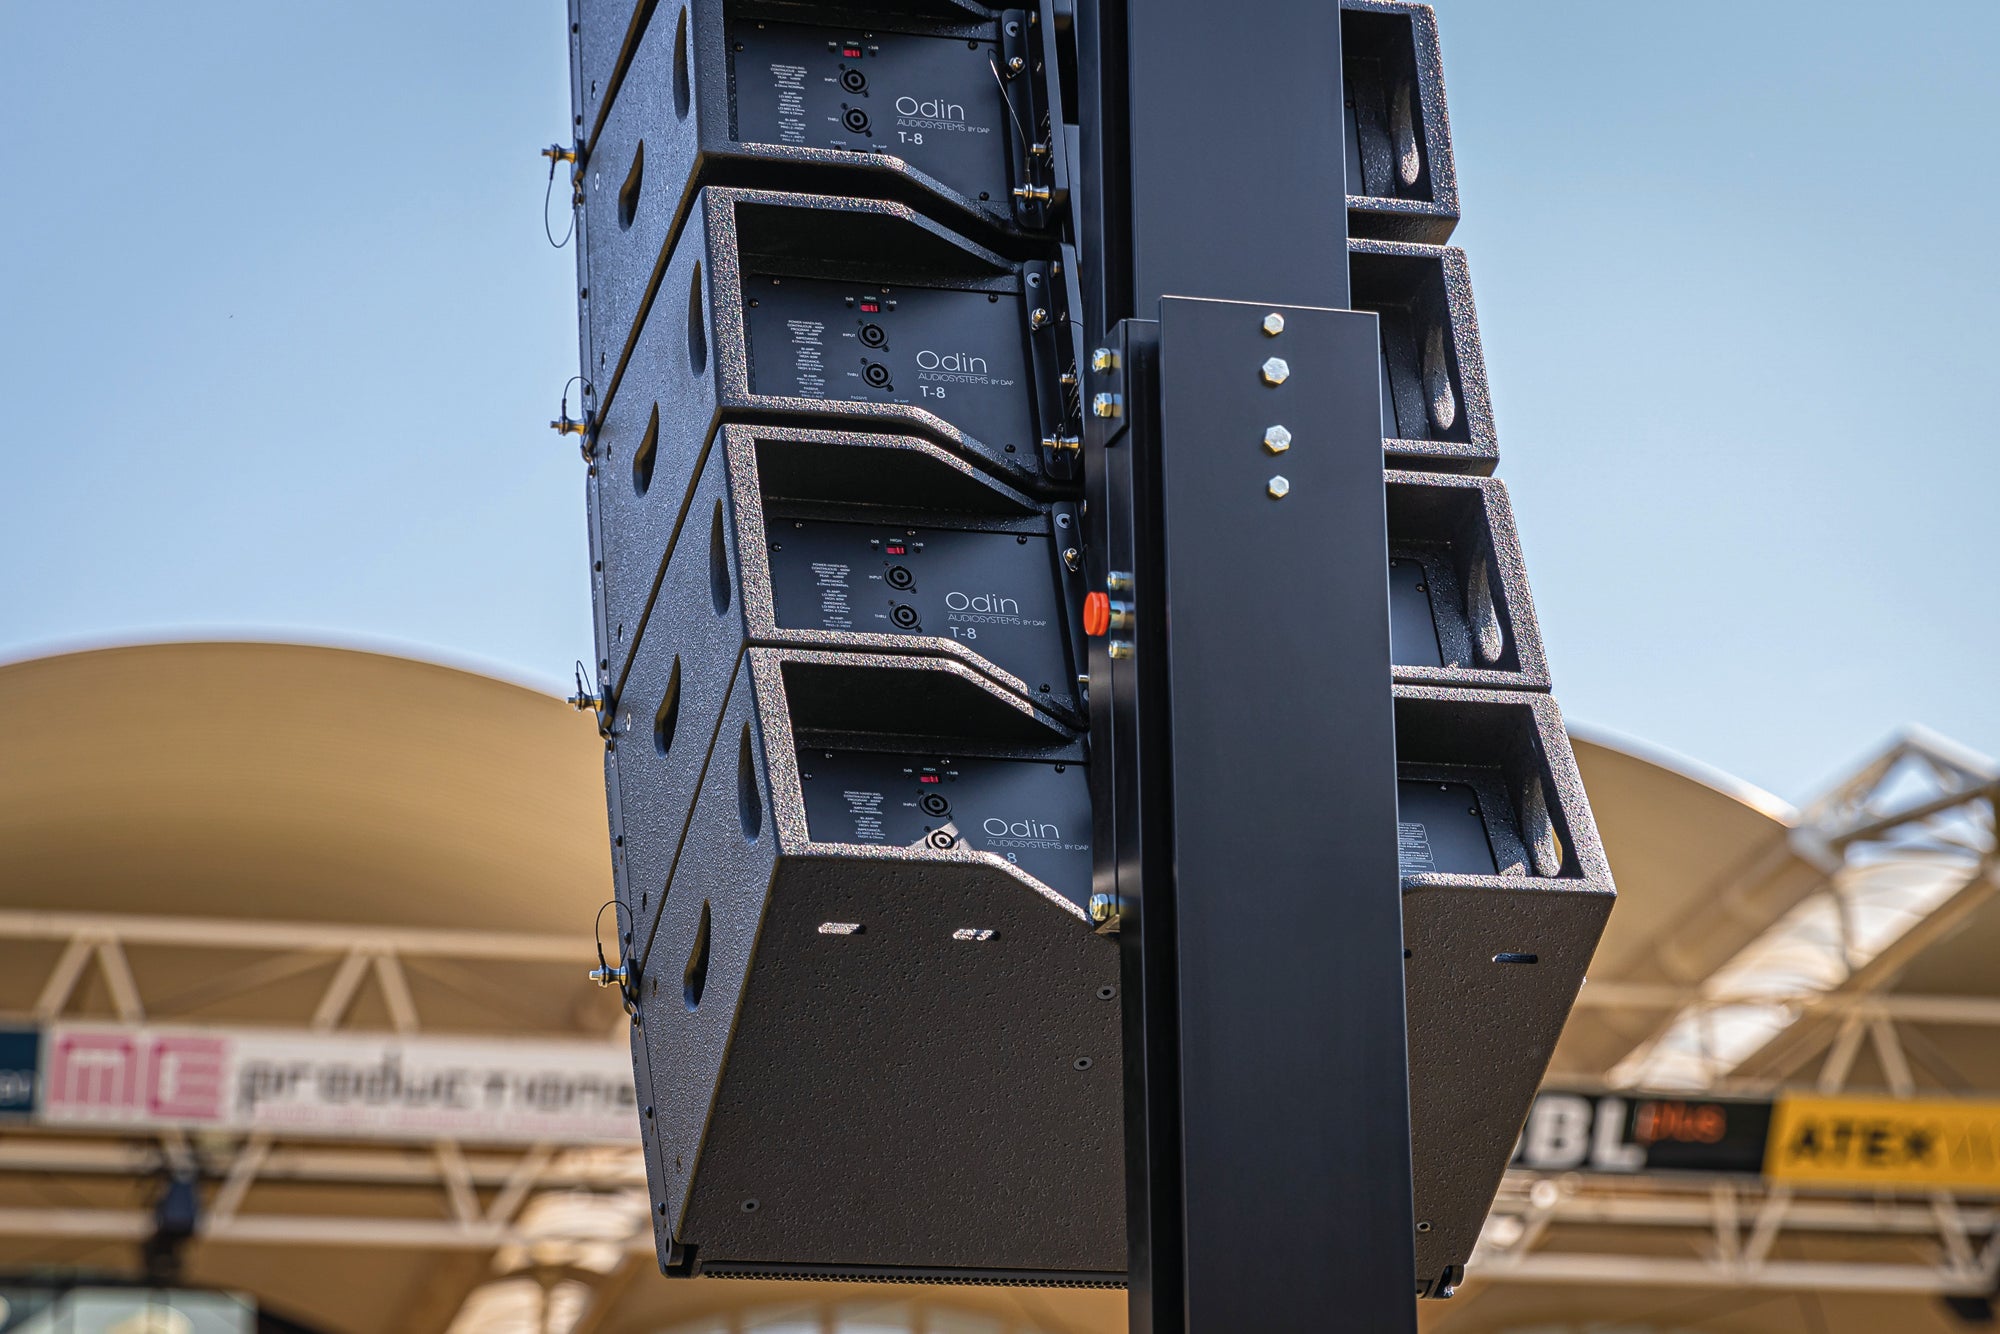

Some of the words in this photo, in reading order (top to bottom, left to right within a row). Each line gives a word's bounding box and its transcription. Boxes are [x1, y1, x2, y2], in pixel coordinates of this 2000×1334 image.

[896, 96, 964, 120] Odin
[896, 118, 966, 132] AUDIOSYSTEMS
[898, 132, 923, 145] T-8
[916, 350, 987, 373] Odin
[918, 372, 988, 385] AUDIOSYSTEMS
[920, 385, 946, 398] T-8
[946, 592, 1018, 614] Odin
[948, 614, 1020, 625] AUDIOSYSTEMS
[950, 626, 977, 639] T-8
[984, 818, 1060, 839] Odin
[987, 839, 1062, 850] AUDIOSYSTEMS
[1514, 1095, 1648, 1172] BL
